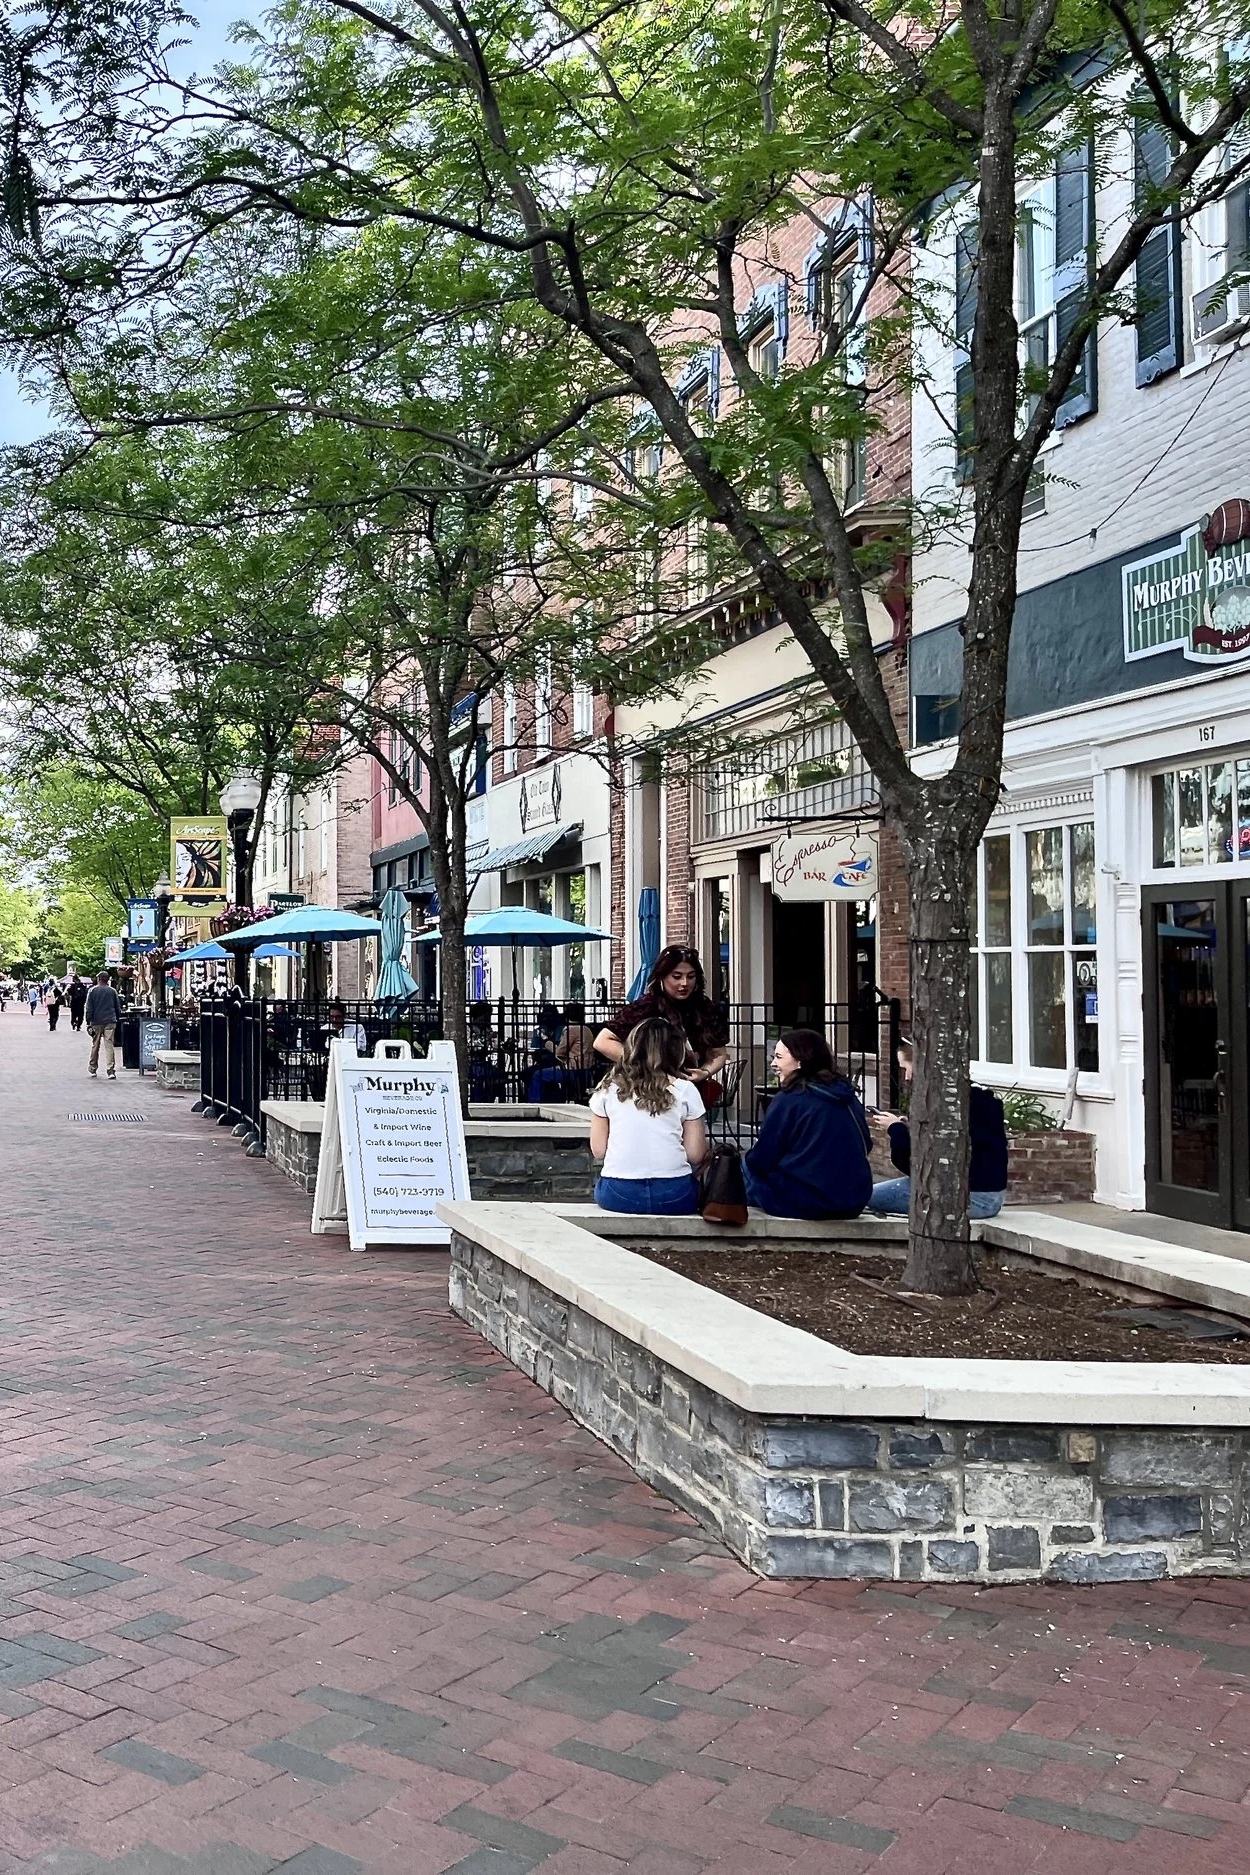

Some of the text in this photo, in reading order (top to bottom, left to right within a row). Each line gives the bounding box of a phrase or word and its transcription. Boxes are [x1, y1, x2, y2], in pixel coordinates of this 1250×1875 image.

[1133, 568, 1203, 612] MURPHY
[1199, 726, 1215, 741] 167
[774, 835, 837, 887] Espresso
[803, 872, 827, 881] BAR
[365, 1076, 436, 1096] Murphy
[365, 1107, 437, 1115] Virginia/Domestic
[395, 1140, 421, 1148] Import
[373, 1187, 445, 1197] (540) 723-9719
